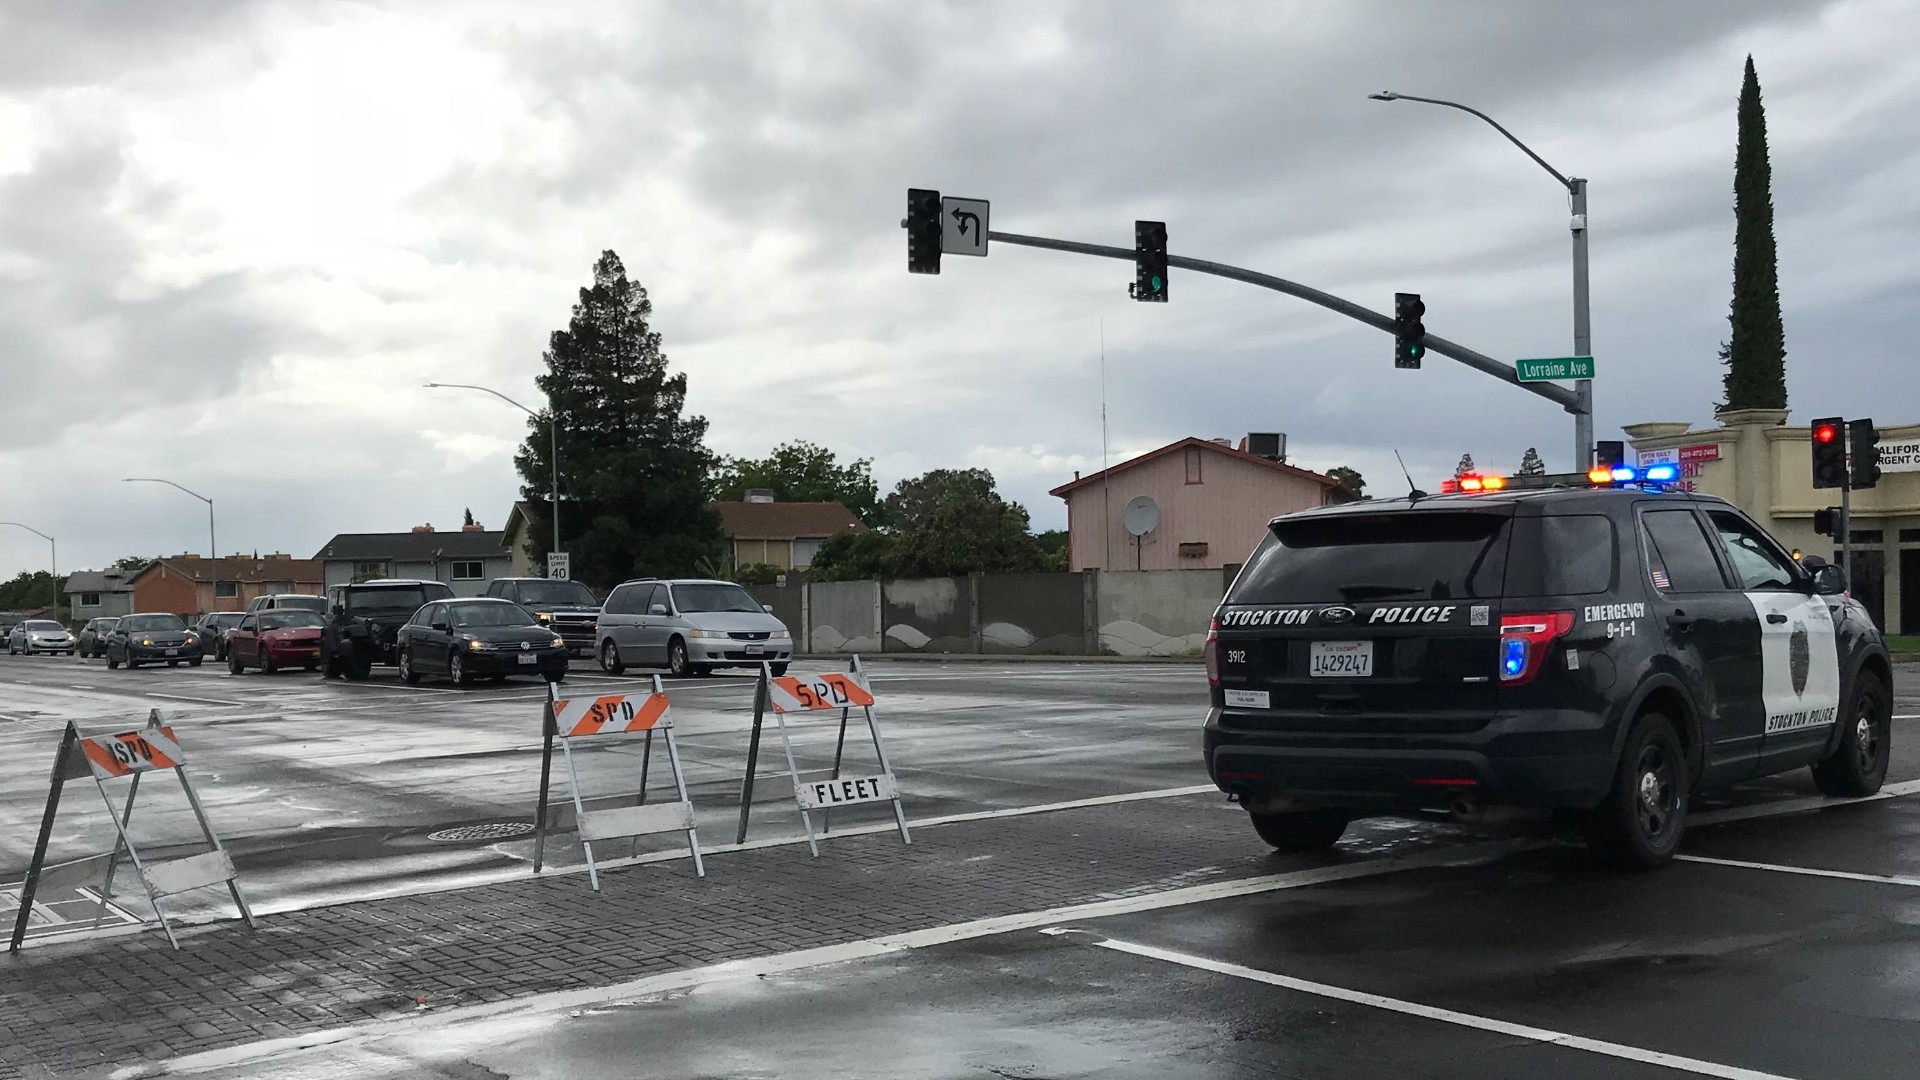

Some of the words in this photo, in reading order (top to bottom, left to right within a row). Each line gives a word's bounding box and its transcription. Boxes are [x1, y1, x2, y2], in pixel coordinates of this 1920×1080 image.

[1523, 362, 1565, 377] Lorraine
[1570, 361, 1587, 375] Ave
[552, 568, 566, 578] 40
[1222, 609, 1313, 626] STOCKTON
[1369, 606, 1456, 624] POLICE
[1585, 602, 1645, 622] EMERGENCY
[1607, 621, 1635, 638] 9-1-1
[1228, 650, 1246, 663] 3912
[1314, 655, 1368, 671] 1429247
[796, 681, 849, 707] SPD
[590, 701, 634, 723] SPD
[1768, 711, 1807, 730] STOCKTON
[1809, 707, 1835, 723] POLICE
[816, 778, 879, 803] FLEET
